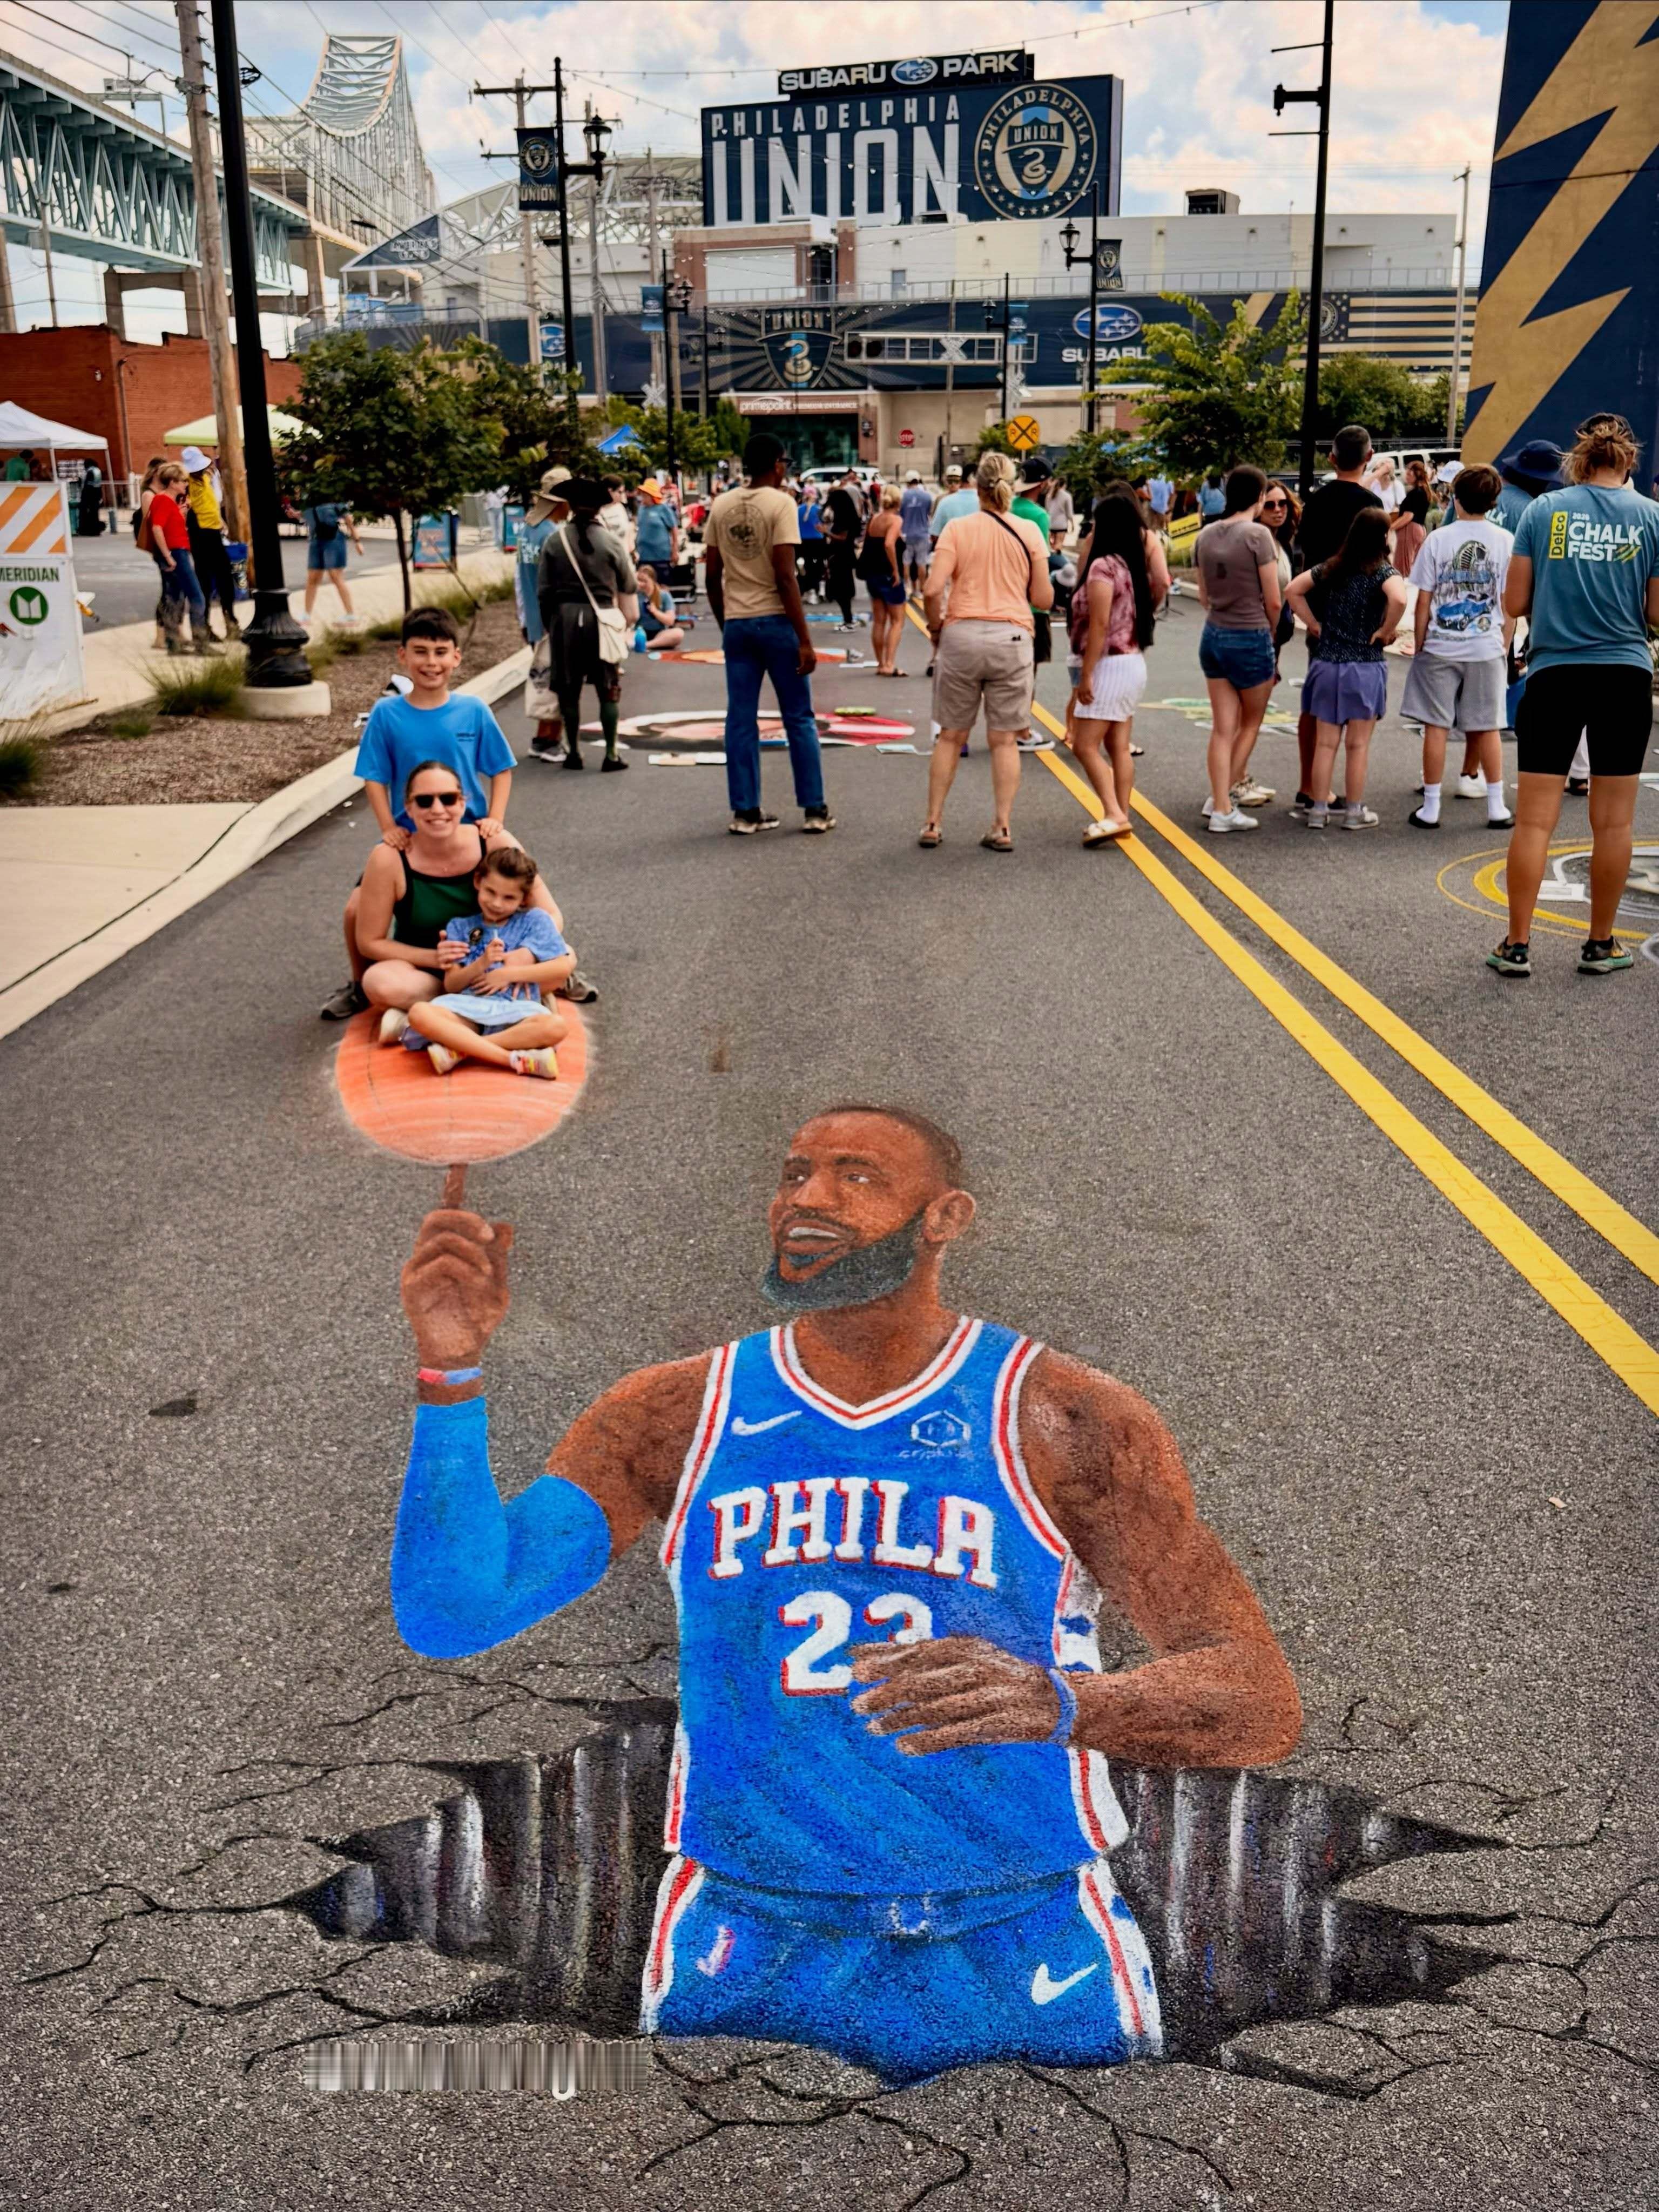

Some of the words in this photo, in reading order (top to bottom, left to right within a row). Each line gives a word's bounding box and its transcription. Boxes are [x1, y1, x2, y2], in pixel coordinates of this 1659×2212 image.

[781, 64, 886, 91] SUBARU
[943, 53, 1019, 77] PARK
[711, 95, 960, 138] PHILADELPHIA
[981, 89, 1091, 152] PHILADELPHIA
[1014, 124, 1058, 143] UNION
[712, 123, 960, 227] UNION
[521, 187, 557, 202] UNION
[772, 311, 824, 330] UNION
[1551, 515, 1566, 556] Delco
[1567, 541, 1617, 562] FEST
[1568, 521, 1644, 545] CHALK
[708, 1477, 997, 1589] PHILA
